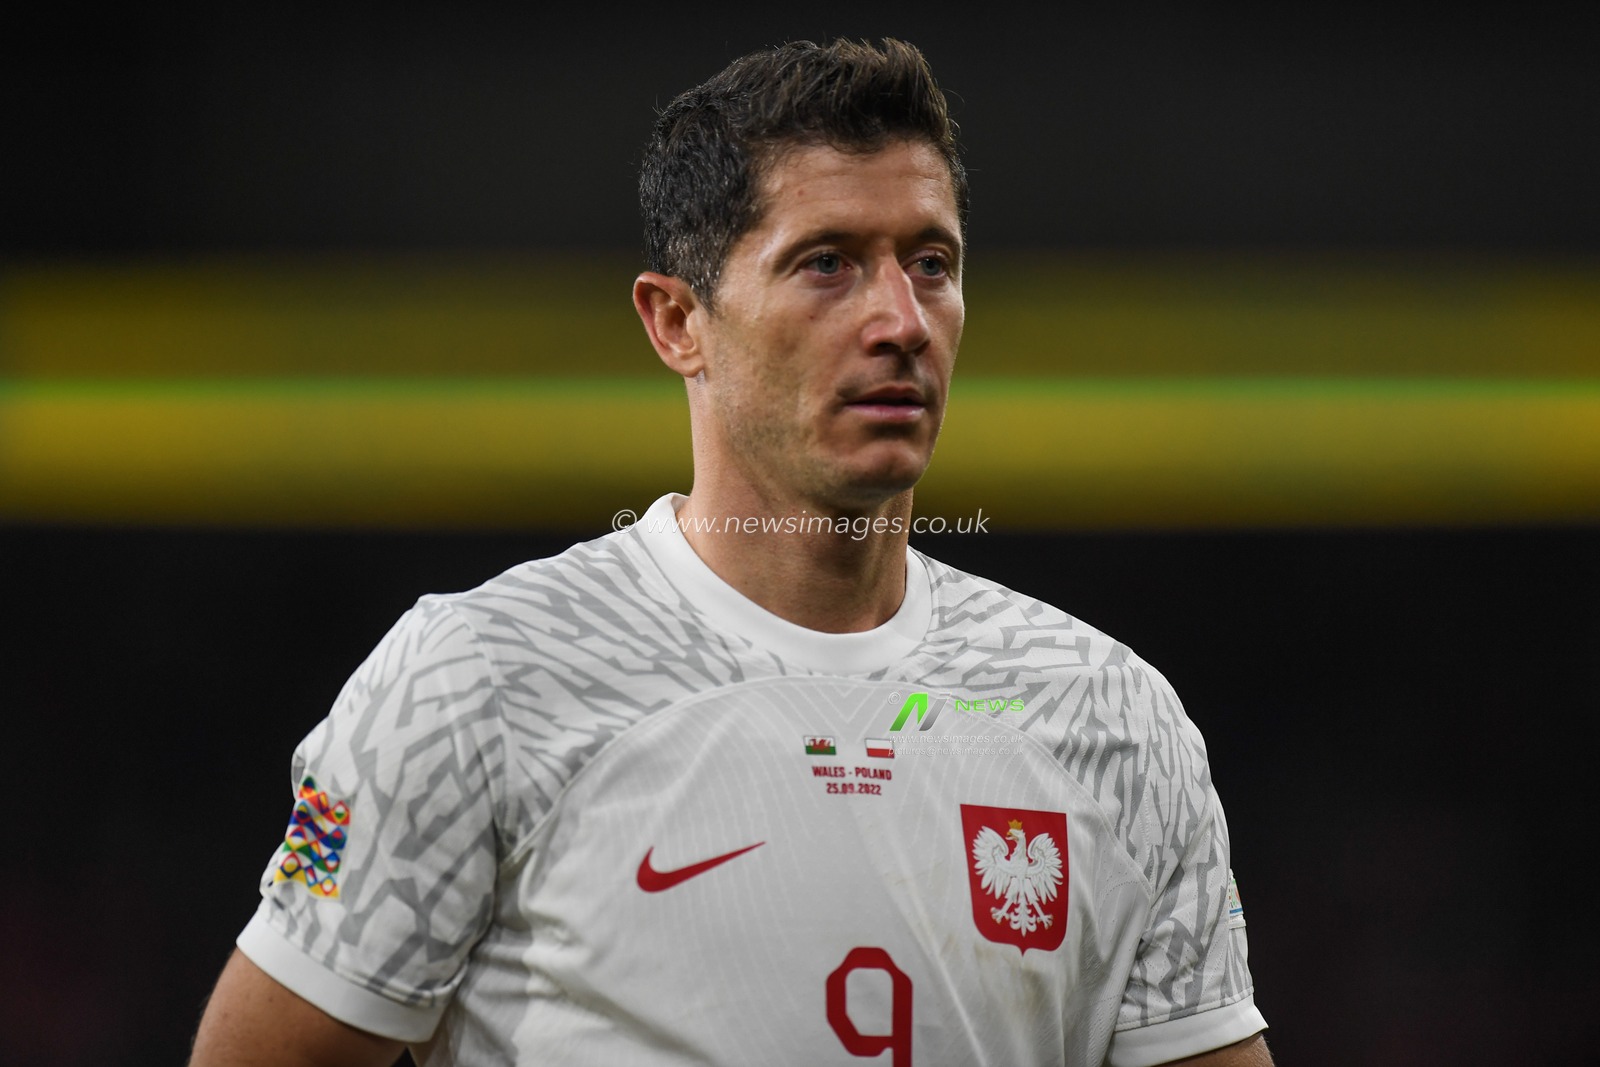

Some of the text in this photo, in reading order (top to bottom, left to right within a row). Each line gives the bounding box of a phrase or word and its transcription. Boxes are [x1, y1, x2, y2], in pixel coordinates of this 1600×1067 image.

[812, 766, 846, 778] WALES
[855, 766, 892, 781] POLAND
[826, 782, 882, 796] 25.09.2022
[825, 946, 913, 1067] 9
